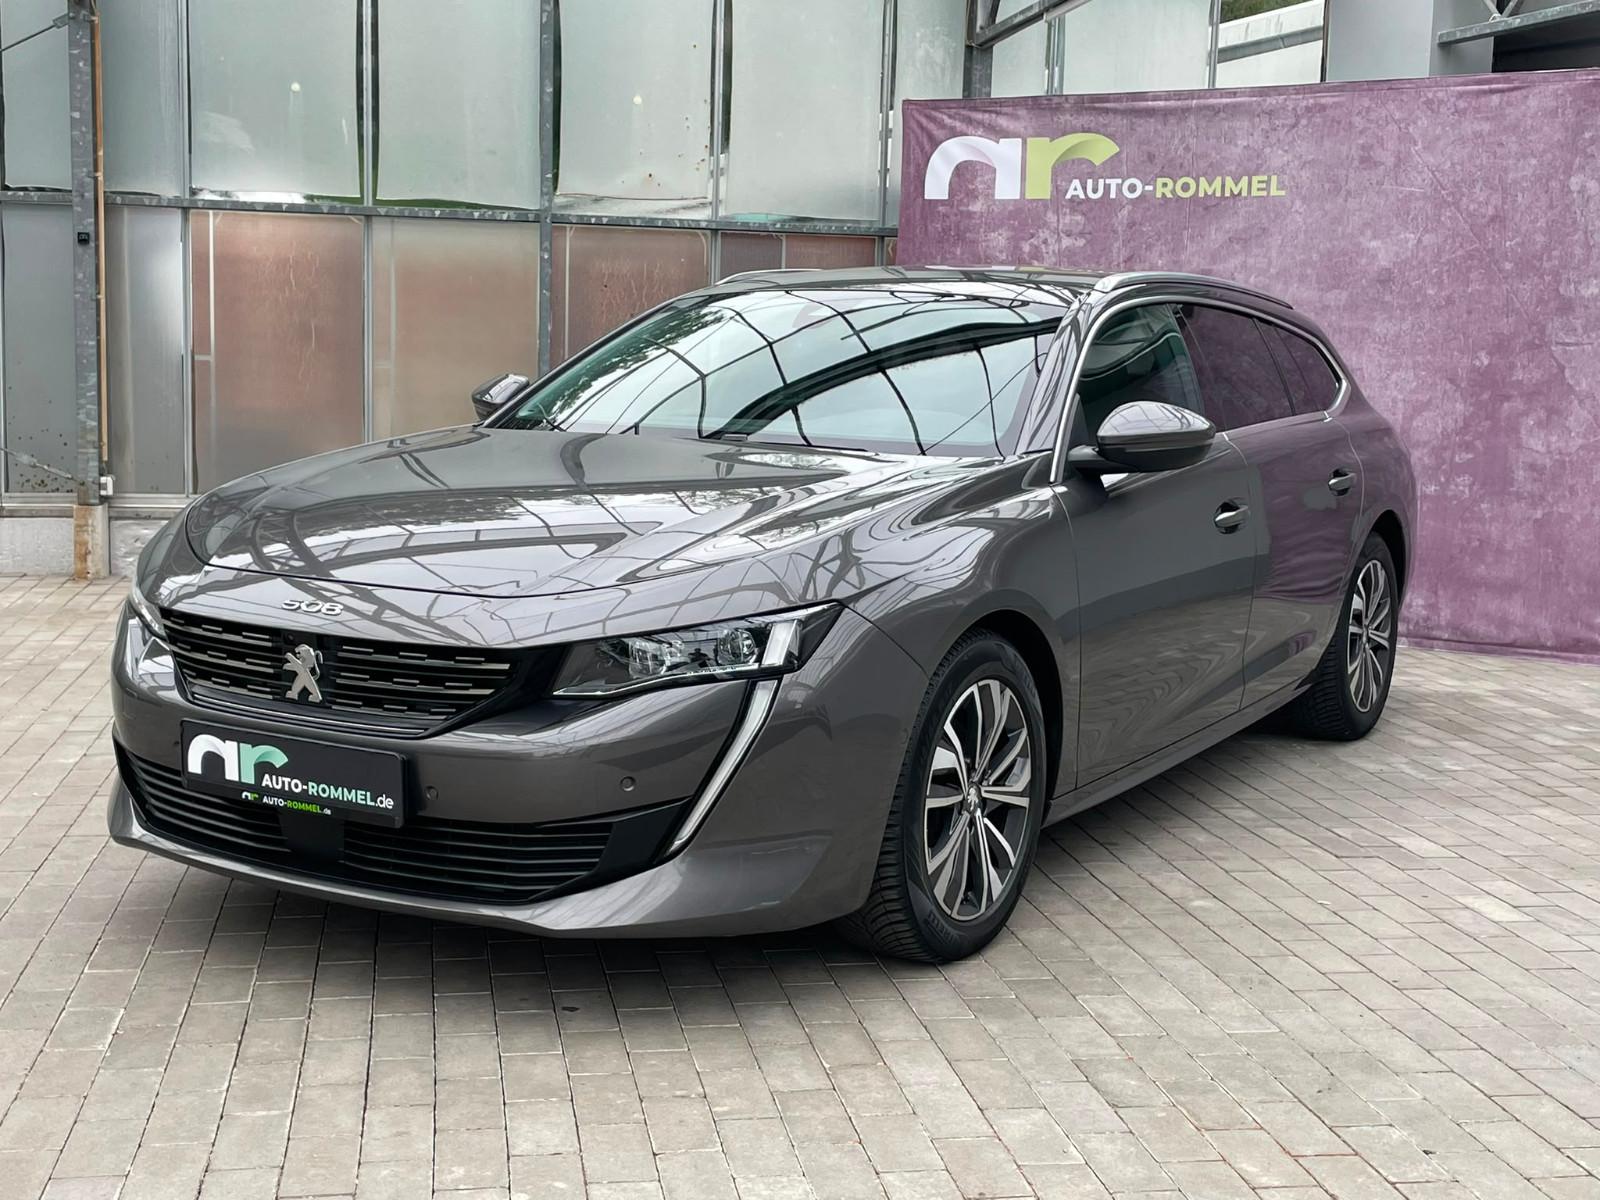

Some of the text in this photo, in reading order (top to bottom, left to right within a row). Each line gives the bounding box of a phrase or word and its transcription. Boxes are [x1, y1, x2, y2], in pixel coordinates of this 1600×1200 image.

[1065, 175, 1286, 199] AUTO-ROMMEL
[281, 600, 344, 616] 508
[261, 774, 394, 809] AUTO-ROMMEL.de
[262, 795, 332, 815] AUTO-ROMMEL.de
